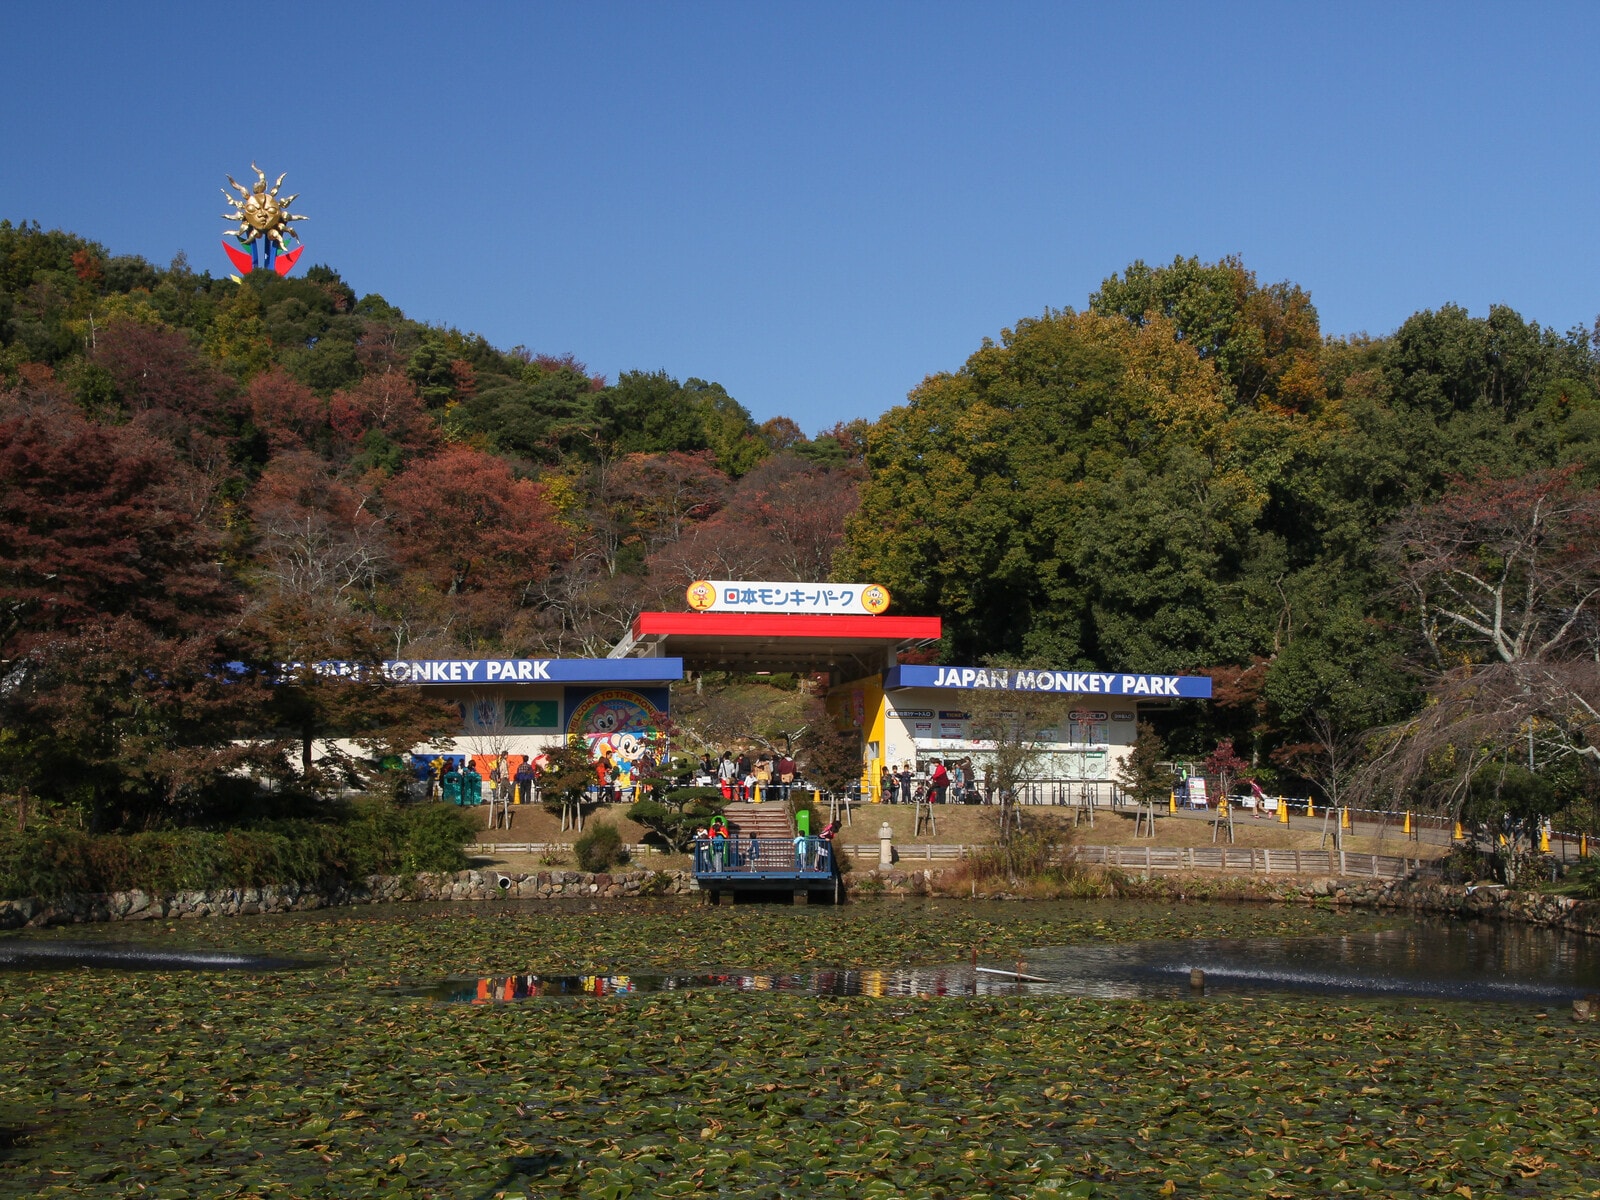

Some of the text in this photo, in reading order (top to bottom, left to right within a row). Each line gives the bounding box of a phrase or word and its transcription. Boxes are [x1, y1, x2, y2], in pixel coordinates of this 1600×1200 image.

[724, 588, 853, 606] 日本モンキーパーク
[486, 660, 551, 681] PARK
[933, 668, 1180, 696] JAPAN MONKEY PARK
[601, 692, 613, 700] TO
[614, 692, 633, 700] THE
